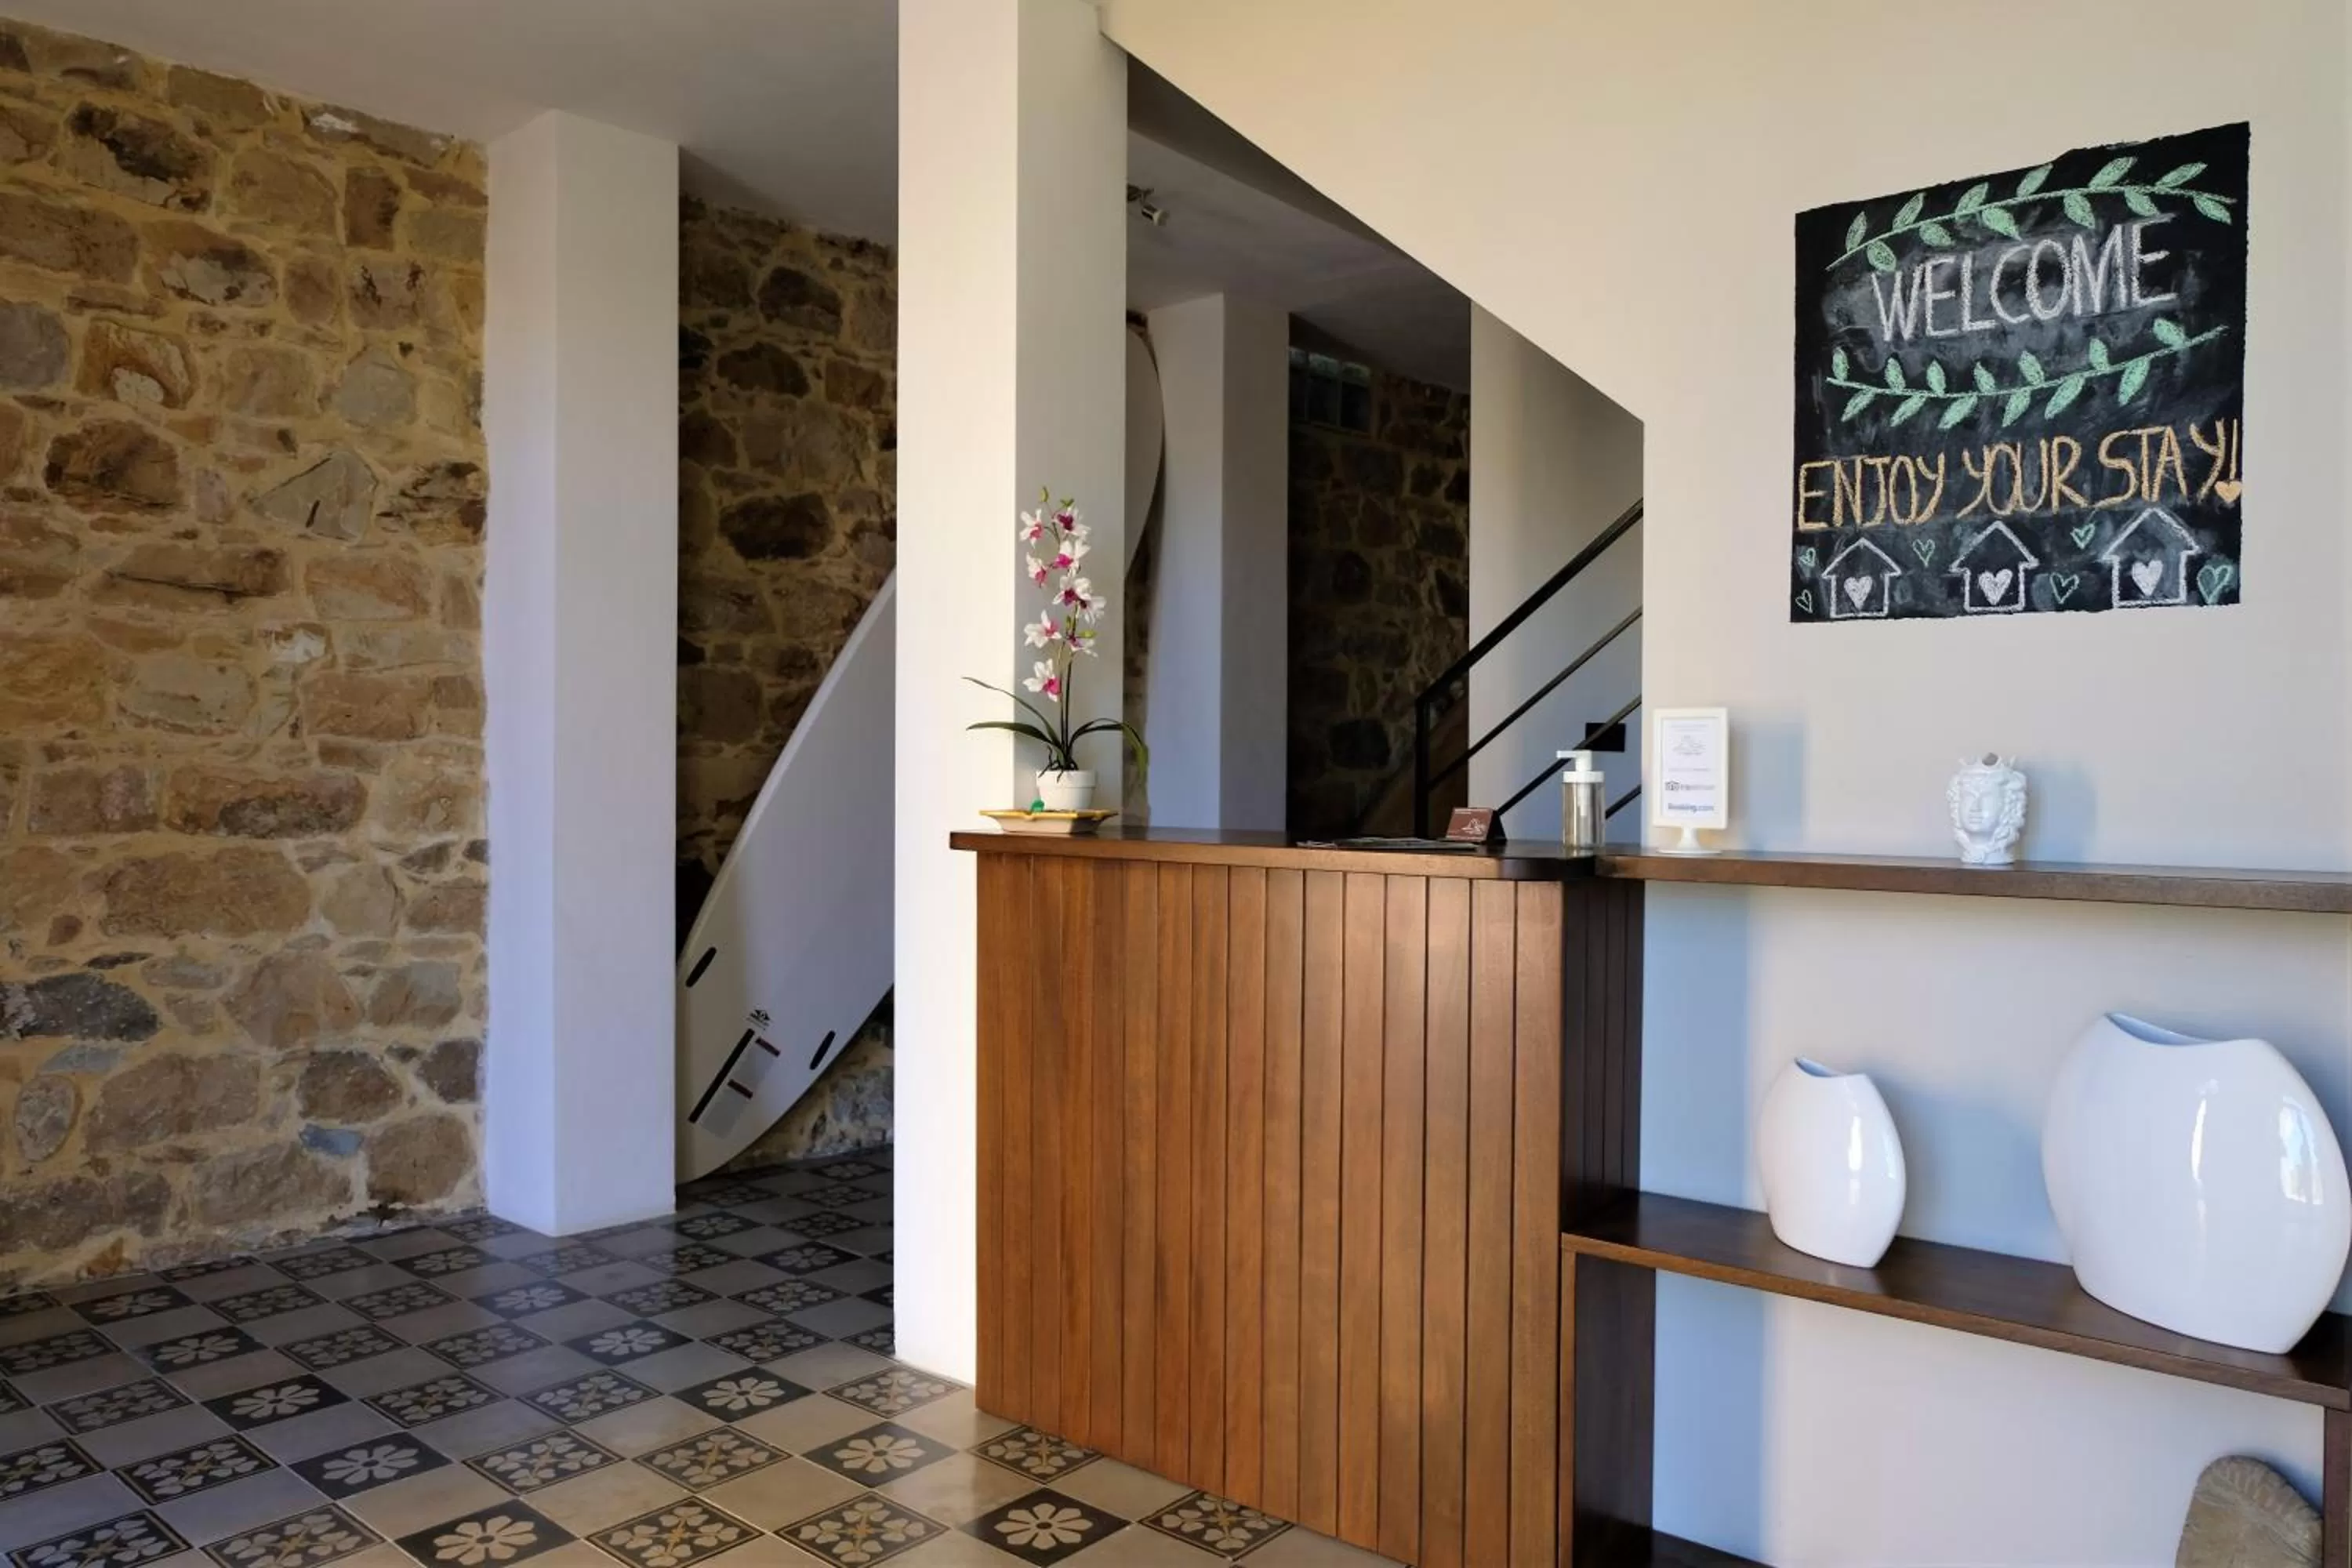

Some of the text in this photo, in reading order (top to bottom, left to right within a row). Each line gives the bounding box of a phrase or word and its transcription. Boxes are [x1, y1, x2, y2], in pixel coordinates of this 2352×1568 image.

[1871, 212, 2179, 342] WELCOME
[1798, 418, 2242, 531] ENJOY YOUR STAY!
